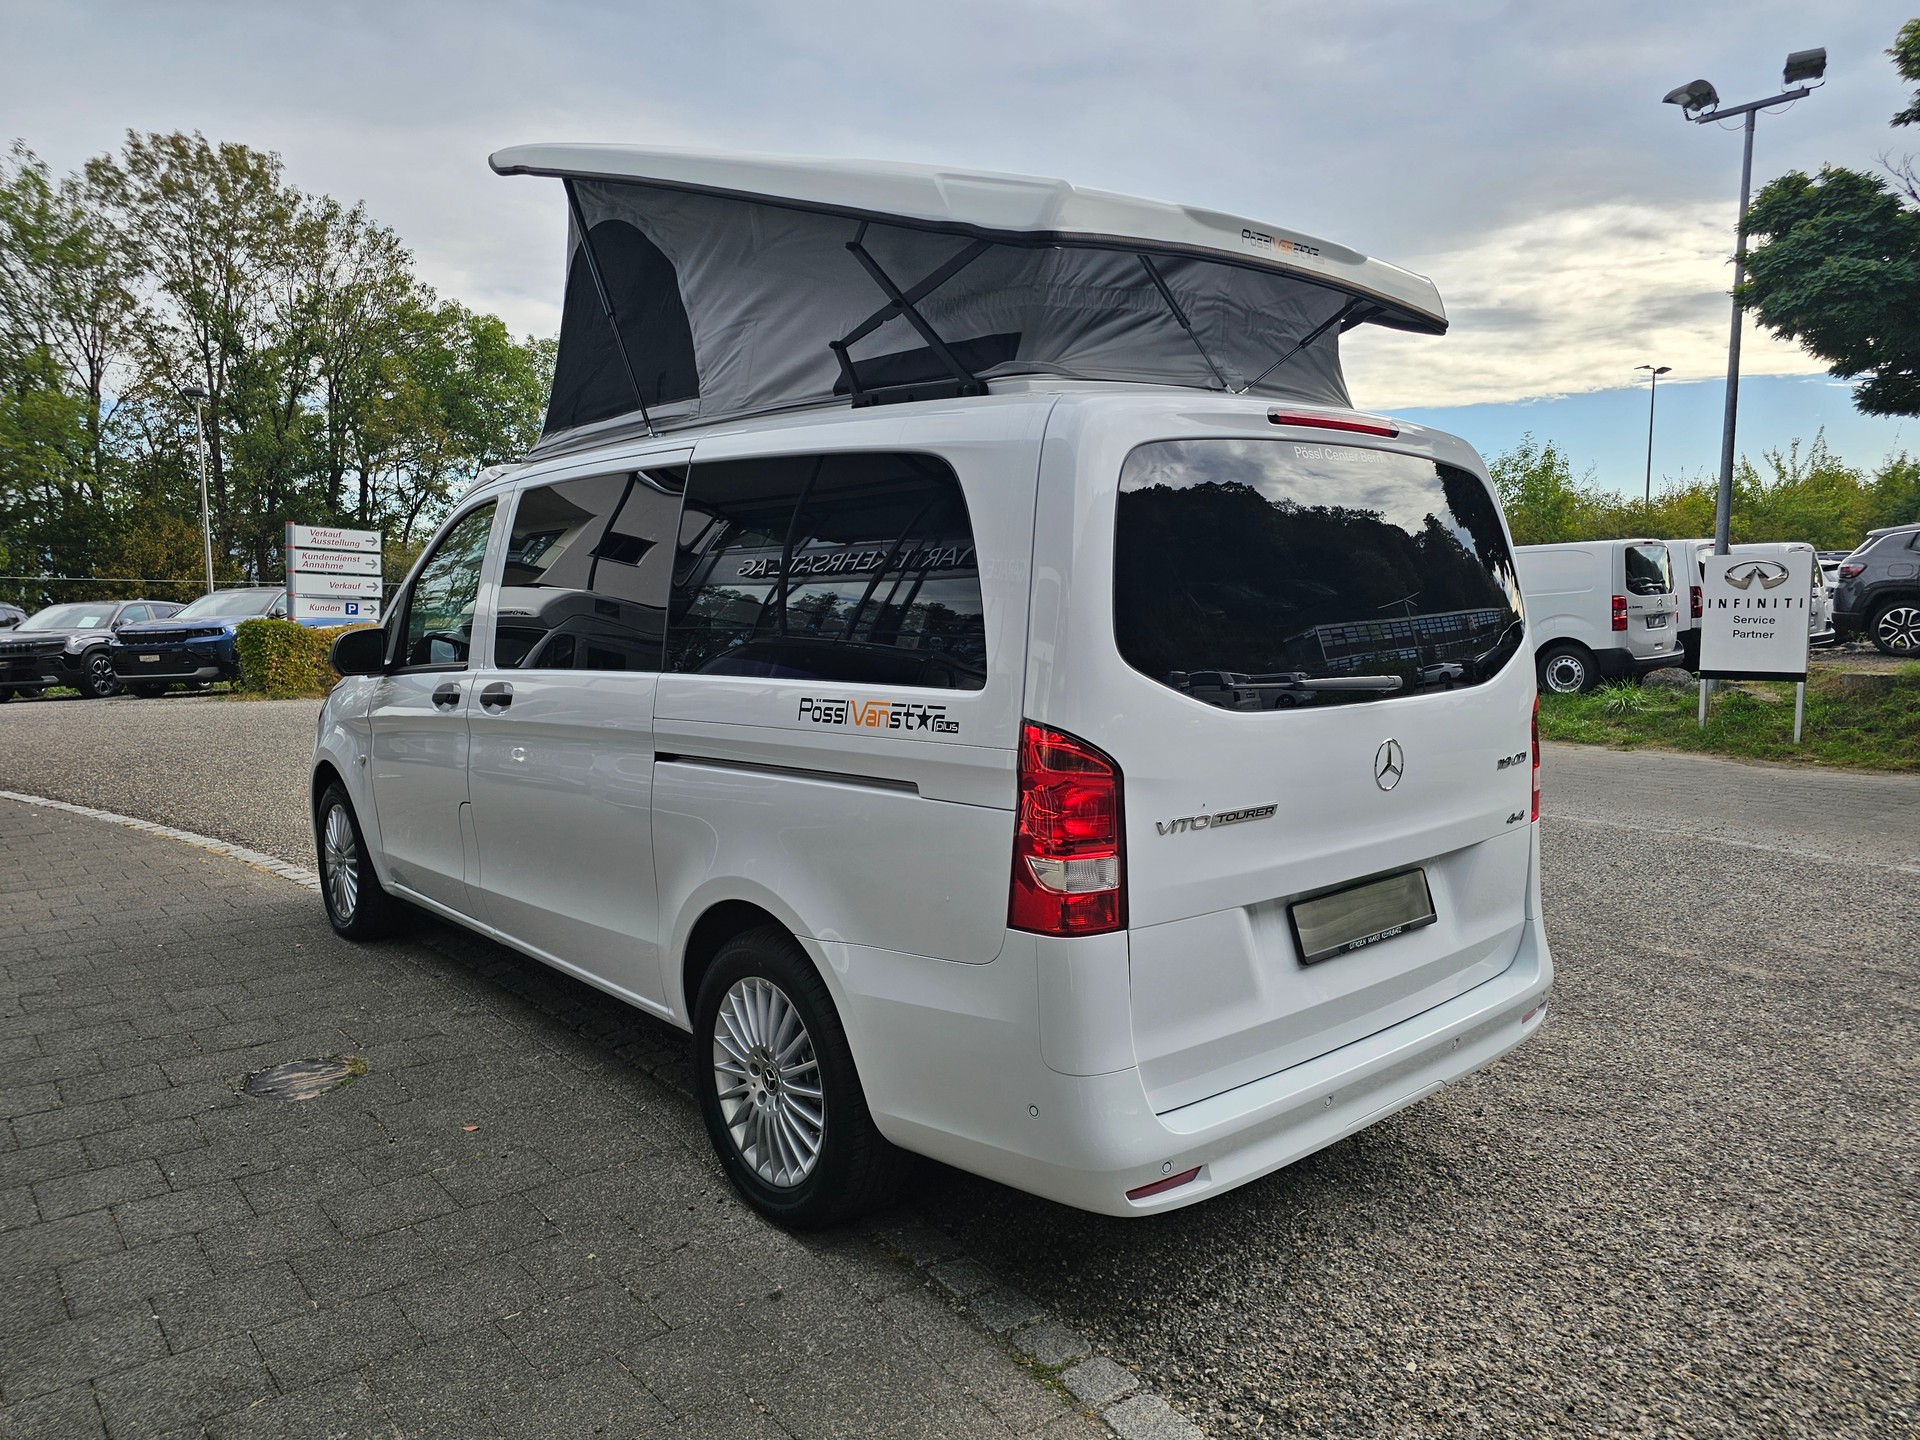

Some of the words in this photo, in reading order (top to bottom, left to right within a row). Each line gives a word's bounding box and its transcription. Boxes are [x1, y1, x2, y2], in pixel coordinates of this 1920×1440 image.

[1293, 446, 1324, 460] Pössl
[1324, 448, 1358, 462] Center
[310, 529, 342, 538] Verkauf
[310, 537, 360, 548] Ausstellung
[302, 552, 360, 562] Kundendienst
[302, 560, 343, 569] Annahme
[329, 581, 361, 589] Verkauf
[309, 603, 340, 611] Kunden
[1707, 597, 1804, 609] INFINITI
[1733, 615, 1776, 625] Service
[1732, 629, 1775, 639] Partner
[798, 697, 850, 725] Pössl
[936, 722, 959, 732] plus
[1155, 813, 1211, 836] VITO
[1216, 805, 1275, 824] TOURER
